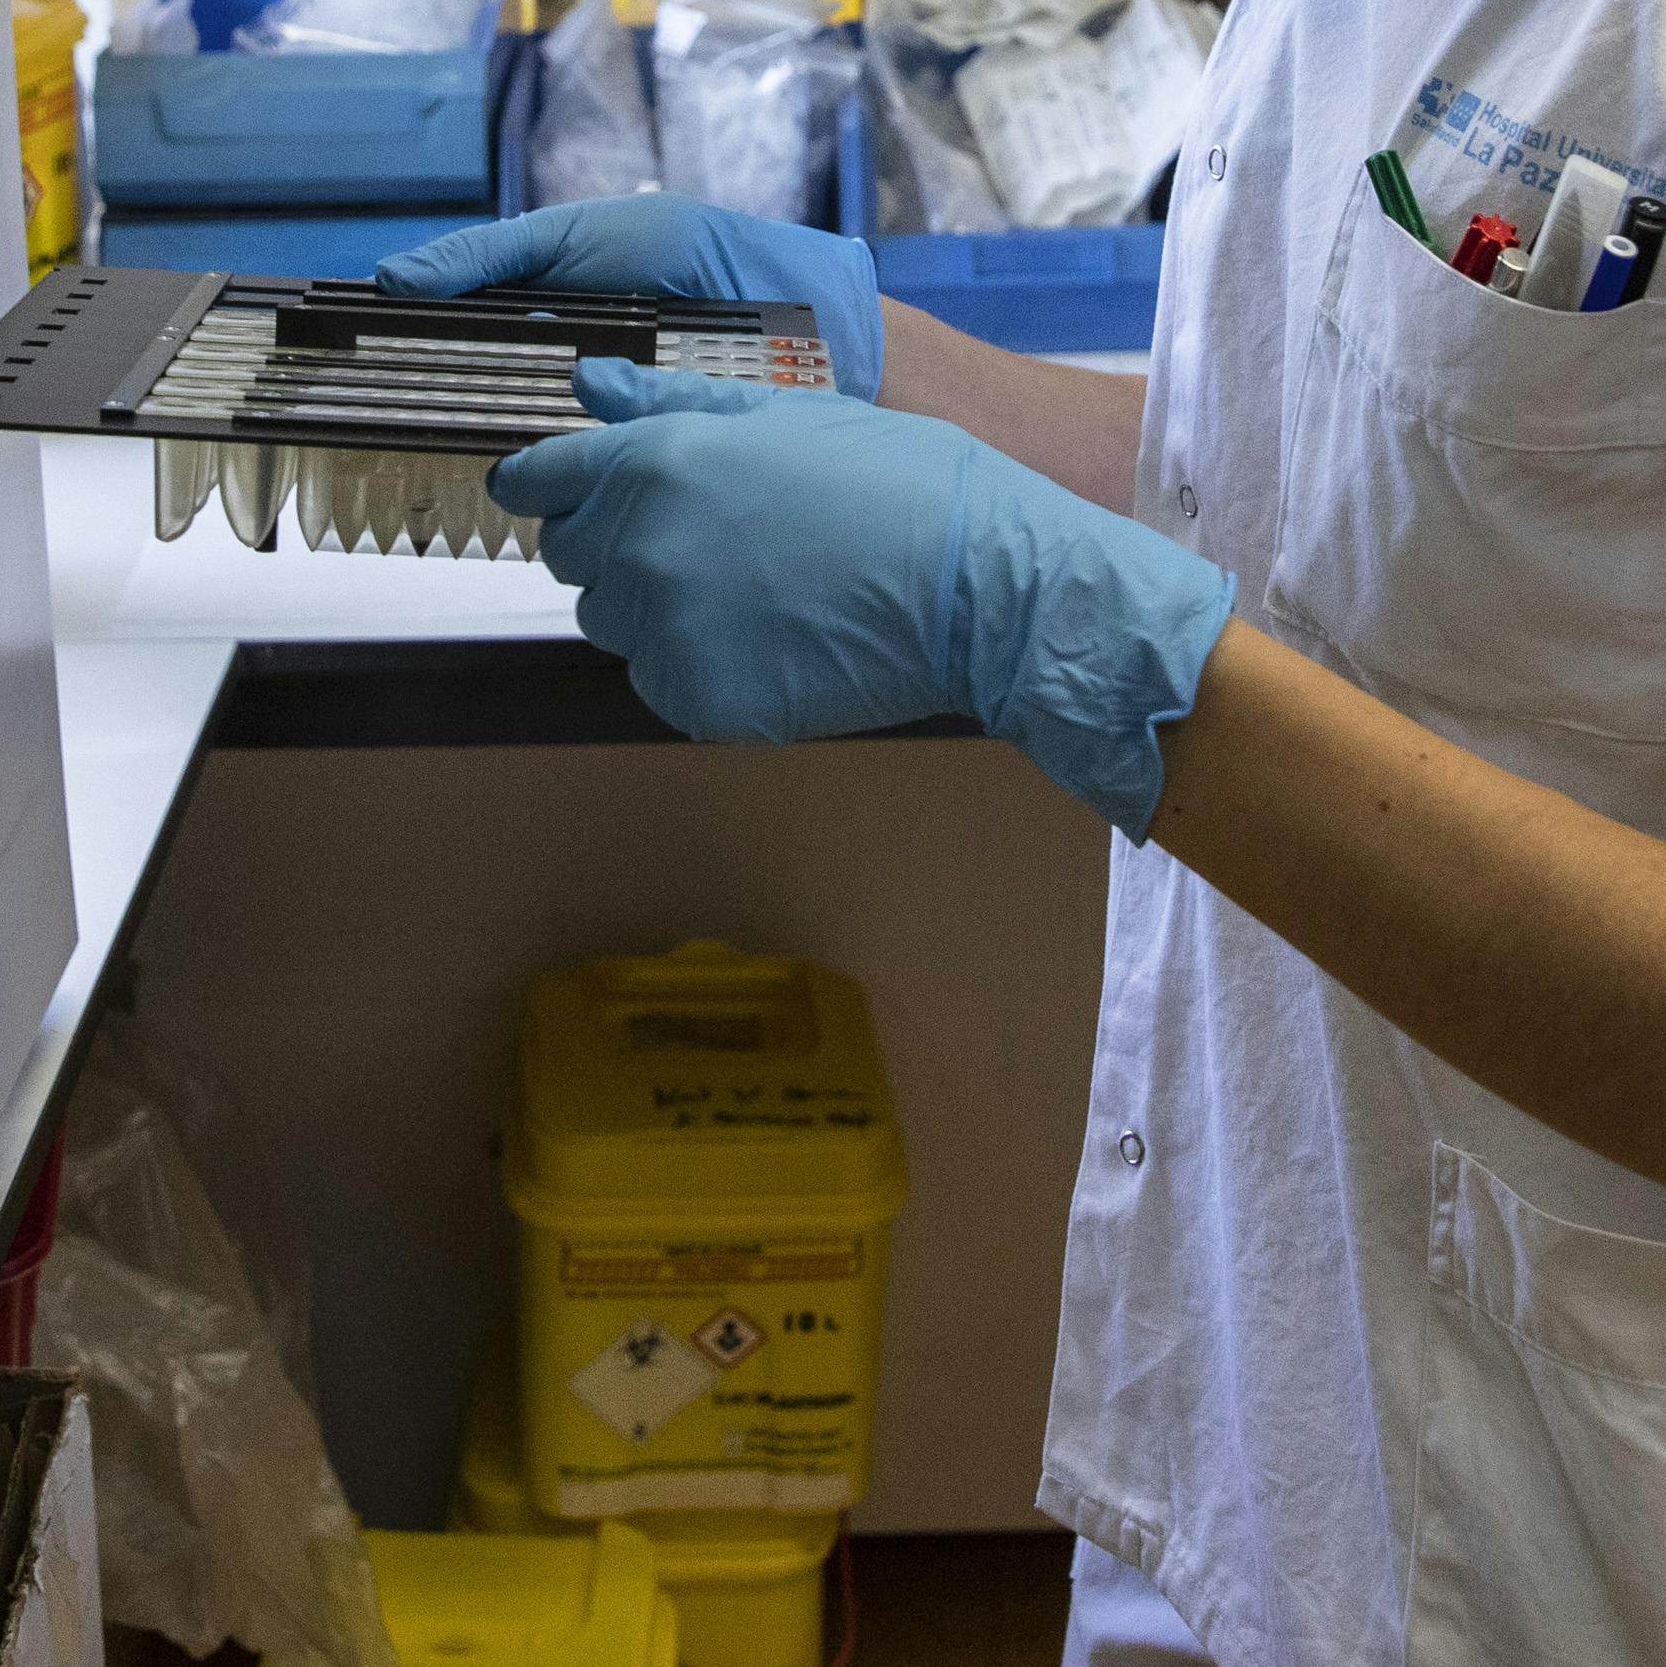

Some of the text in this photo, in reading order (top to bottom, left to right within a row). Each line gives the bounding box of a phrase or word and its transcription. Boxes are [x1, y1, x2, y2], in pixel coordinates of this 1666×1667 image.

[1478, 101, 1551, 152] Hospital
[1463, 126, 1495, 166] La
[1500, 144, 1562, 193] Paz
